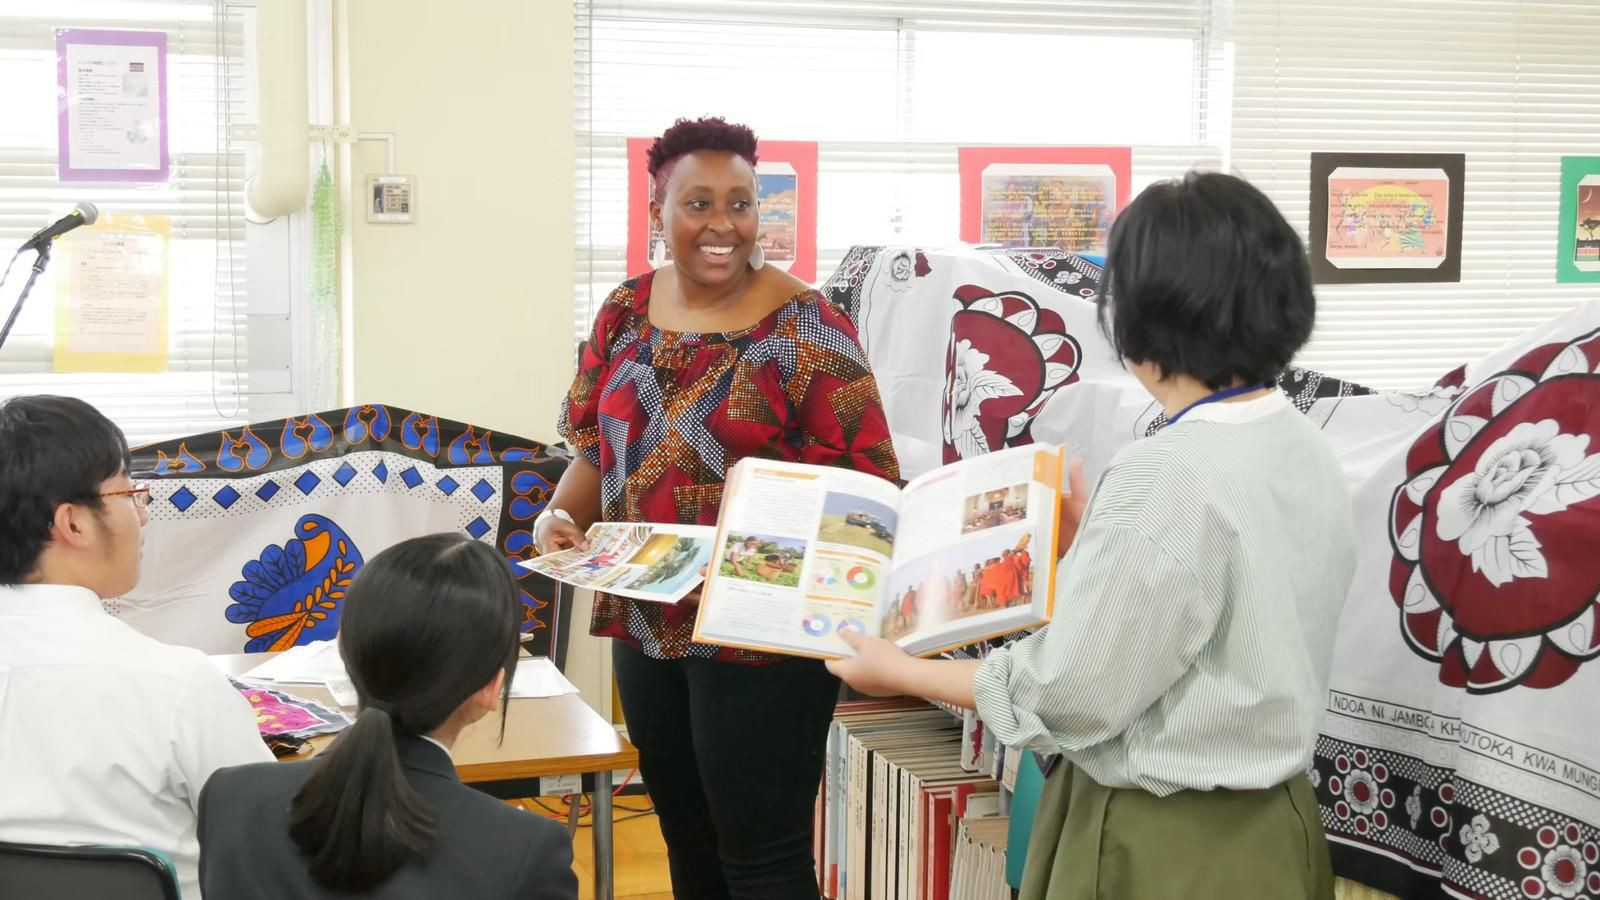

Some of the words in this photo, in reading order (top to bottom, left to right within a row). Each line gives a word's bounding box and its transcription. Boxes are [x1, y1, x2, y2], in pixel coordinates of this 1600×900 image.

[1334, 696, 1365, 715] NDOA
[1372, 705, 1384, 719] NI
[1462, 729, 1514, 760] UTOKA
[1523, 751, 1556, 774] KWA
